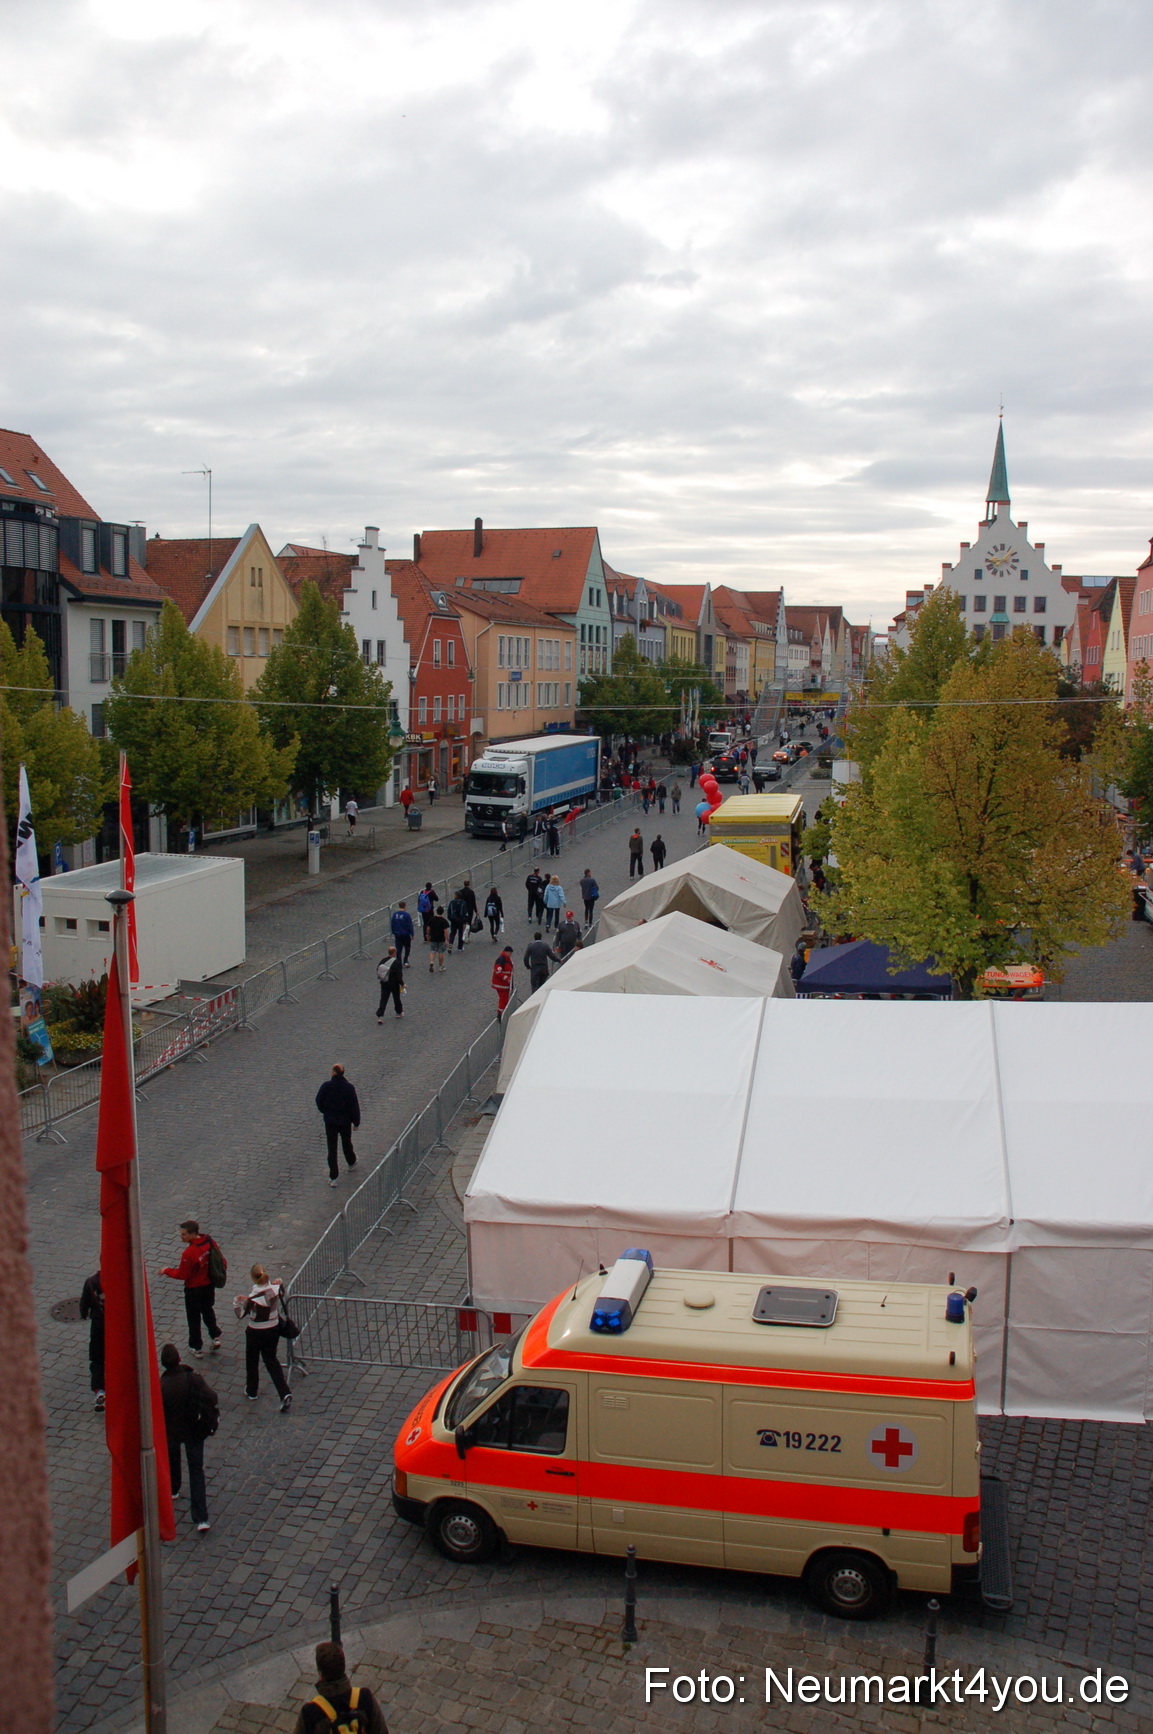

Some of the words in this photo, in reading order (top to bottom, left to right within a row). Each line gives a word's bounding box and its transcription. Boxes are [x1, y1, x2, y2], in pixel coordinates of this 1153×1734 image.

[985, 971, 1034, 979] TUNGSWAGEN
[782, 1430, 802, 1449] 19
[805, 1432, 842, 1453] 222
